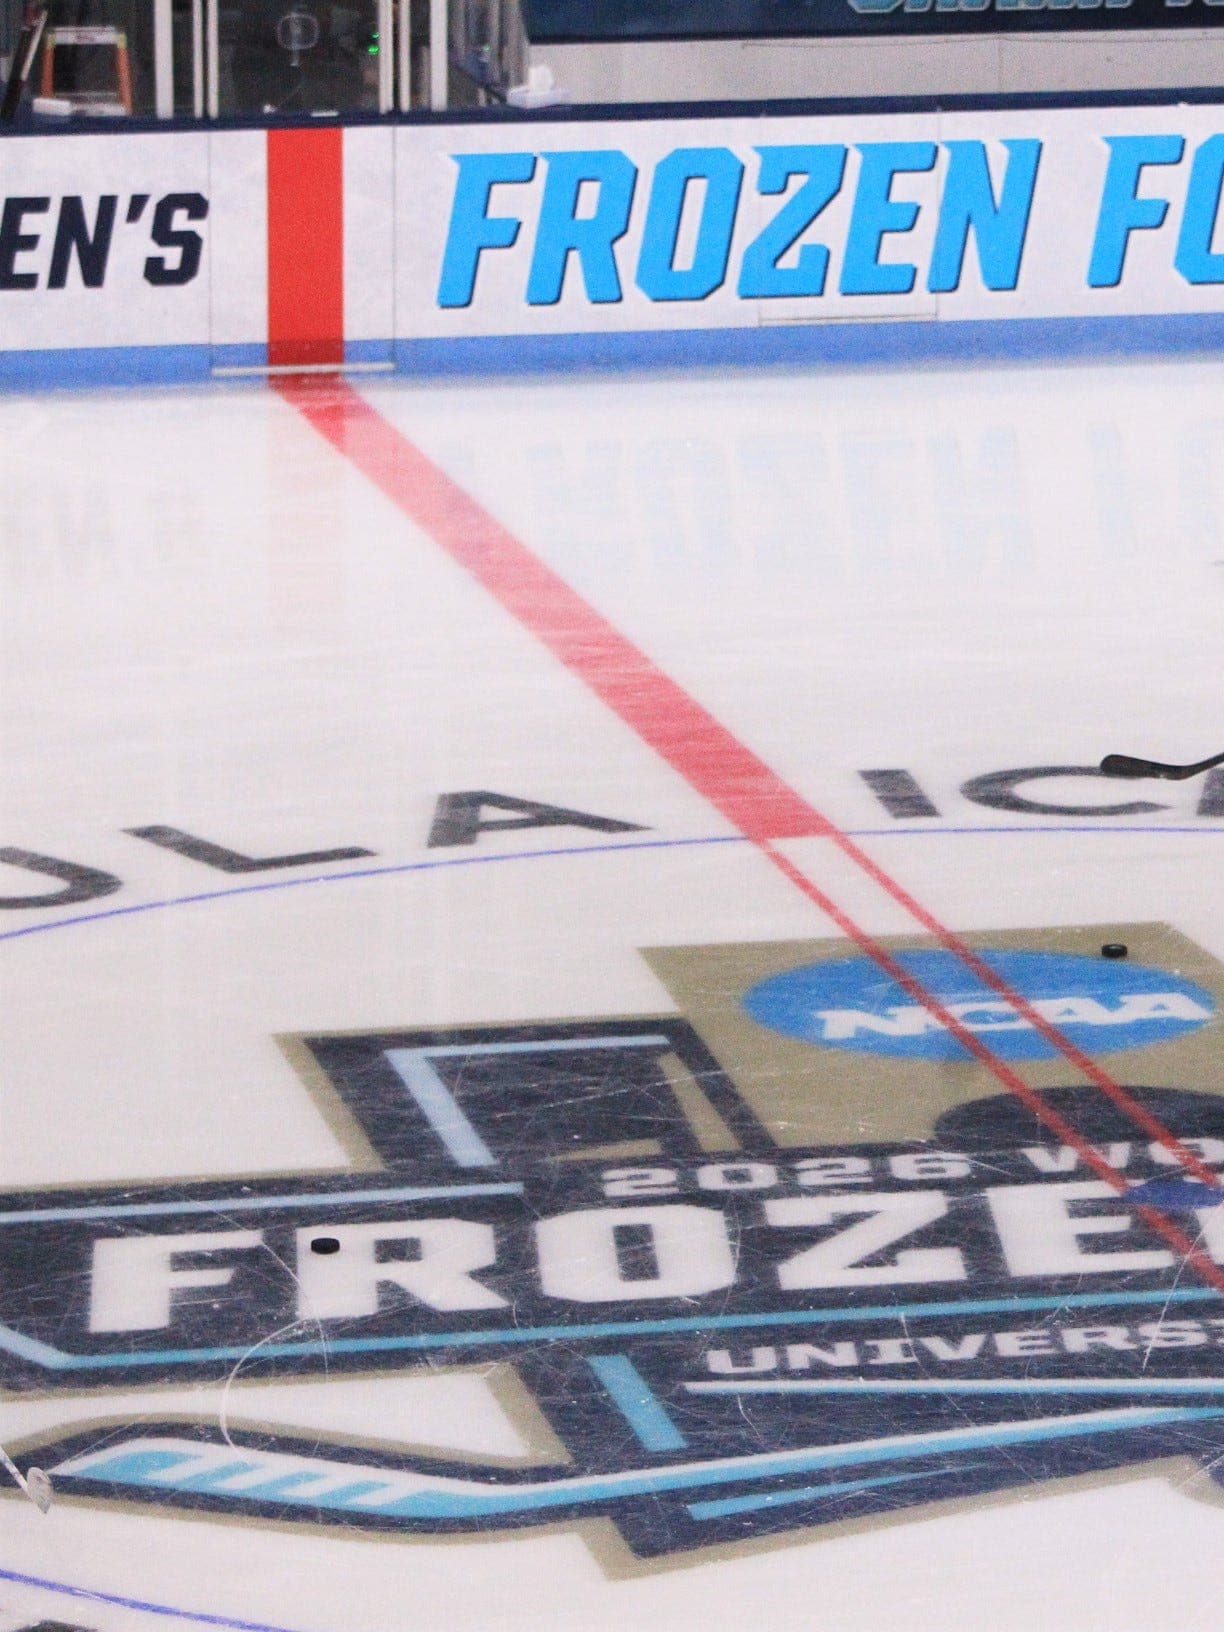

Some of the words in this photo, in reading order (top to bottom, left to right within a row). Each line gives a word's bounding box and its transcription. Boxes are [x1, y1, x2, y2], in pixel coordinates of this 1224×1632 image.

[436, 138, 1043, 309] FROZEN
[816, 992, 1211, 1040] NCAA
[602, 1153, 971, 1198] 2026
